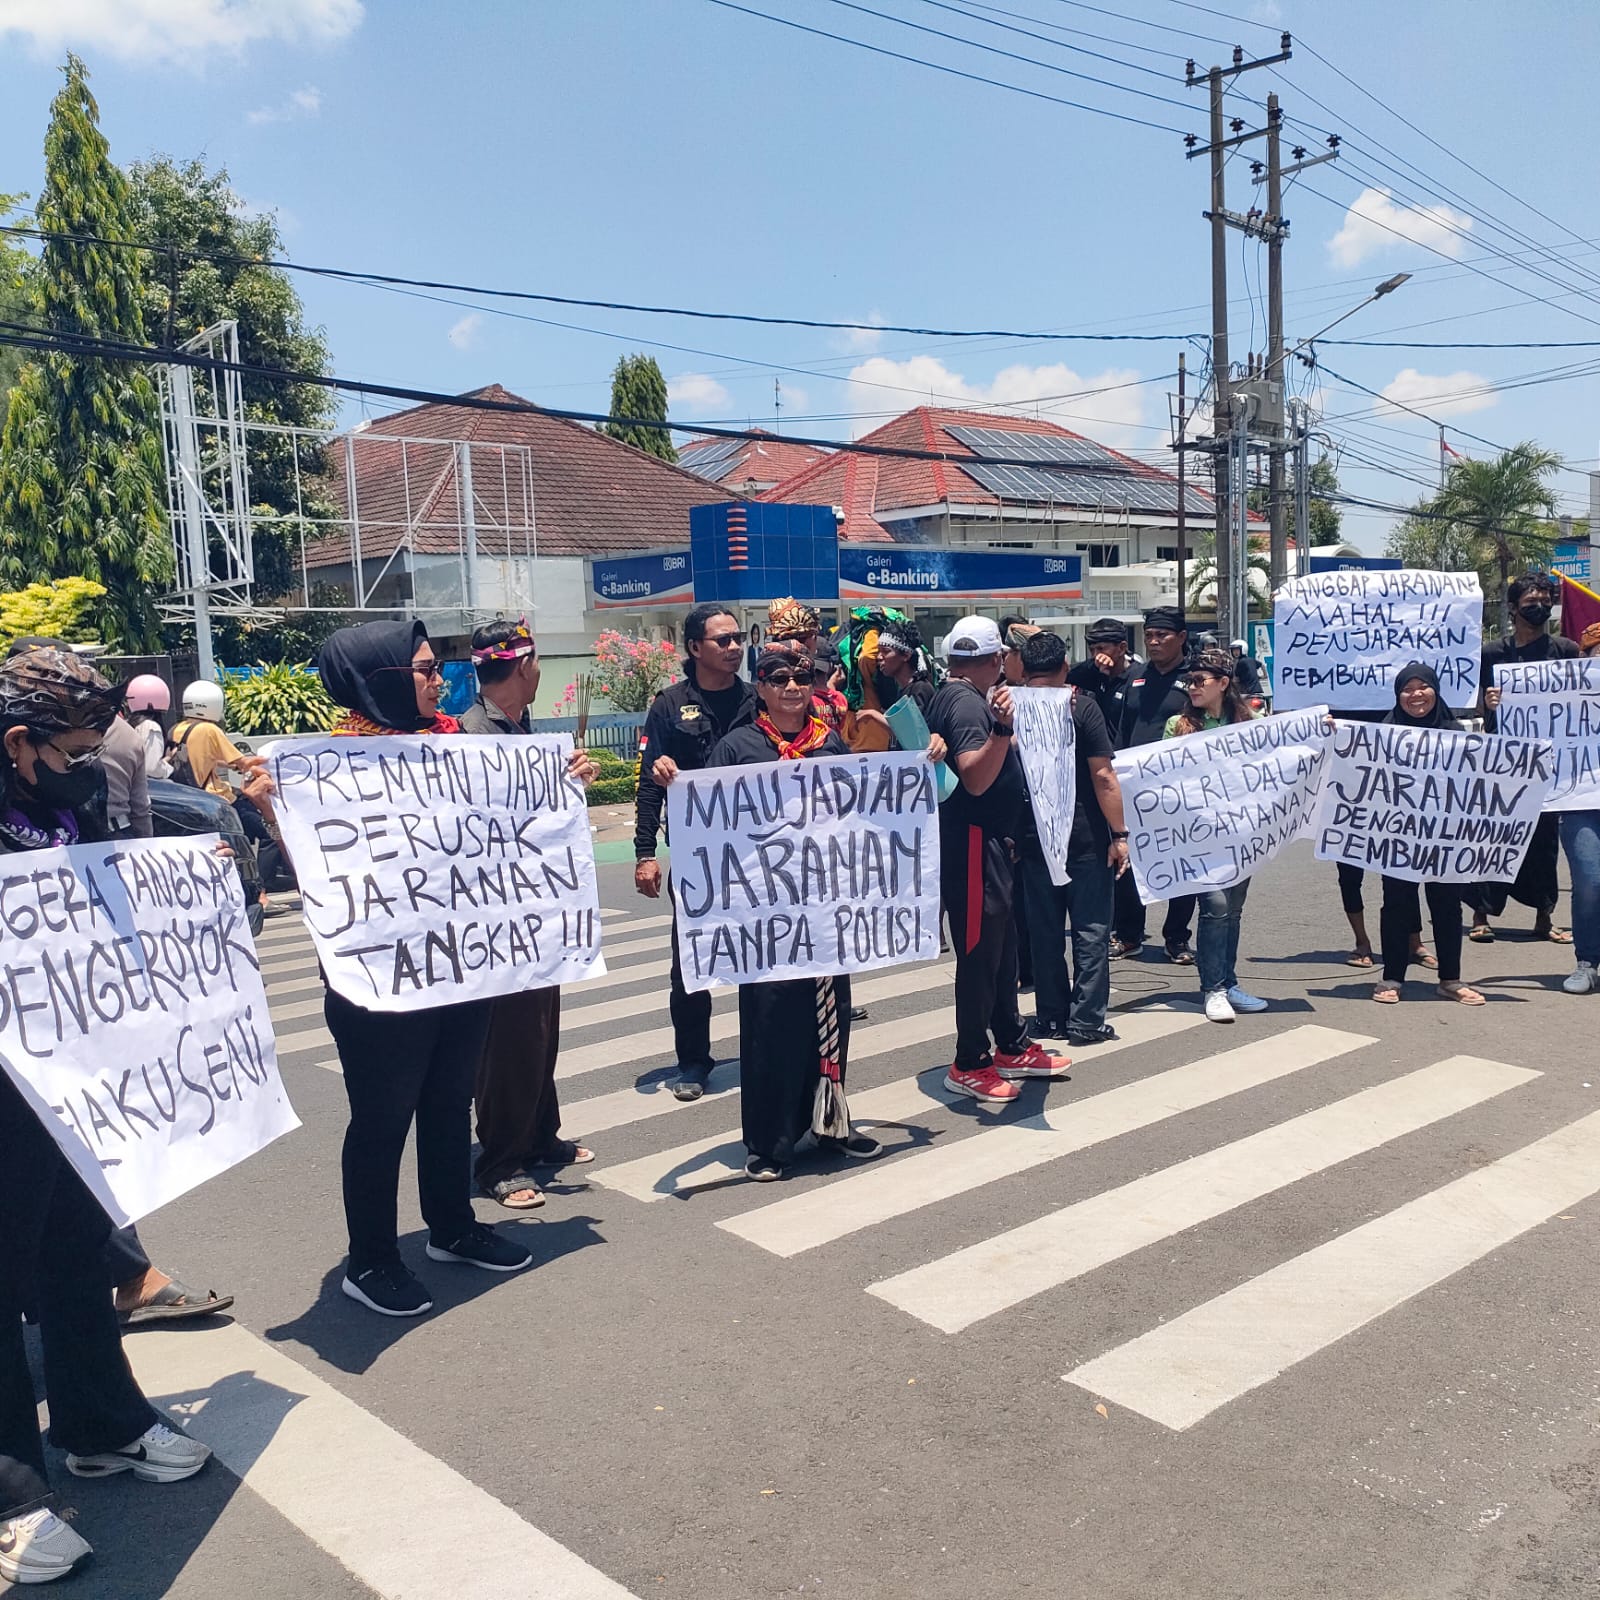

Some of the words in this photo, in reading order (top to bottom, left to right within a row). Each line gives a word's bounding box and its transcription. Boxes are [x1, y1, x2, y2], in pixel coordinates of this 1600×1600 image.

[602, 579, 650, 595] e-Banking
[866, 555, 892, 567] Galeri
[867, 568, 939, 589] e-Banking
[1284, 602, 1403, 628] MAHAL
[1419, 603, 1451, 627] !!!
[1287, 626, 1466, 655] PENJARAKAN
[1500, 660, 1592, 694] PERUSAK
[1137, 747, 1197, 778] KITA
[1205, 714, 1331, 760] MENDUKUNG
[1334, 725, 1450, 771] JANGAN
[1458, 734, 1551, 781] RUSAK
[275, 742, 473, 813] PREMAN
[480, 743, 585, 812] MABUK
[686, 770, 784, 830] MAU
[869, 763, 935, 816] APA
[1133, 770, 1230, 826] POLRI
[1242, 748, 1325, 792] DALAM
[1327, 765, 1528, 817] JARANAN
[314, 814, 543, 873] PERUSAK
[1136, 776, 1322, 861] PENGAMANAN
[1147, 852, 1212, 890] GIAT
[1200, 802, 1315, 885] JARANAN
[1333, 804, 1438, 840] DENGAN
[1439, 818, 1532, 845] LINDUNGI
[681, 827, 921, 918] JARANAN
[1321, 828, 1454, 877] PEMBUAT
[303, 846, 580, 938] JARANAN
[335, 914, 542, 998] TANGKAP
[562, 908, 593, 962] !!!
[686, 914, 815, 979] TANPA
